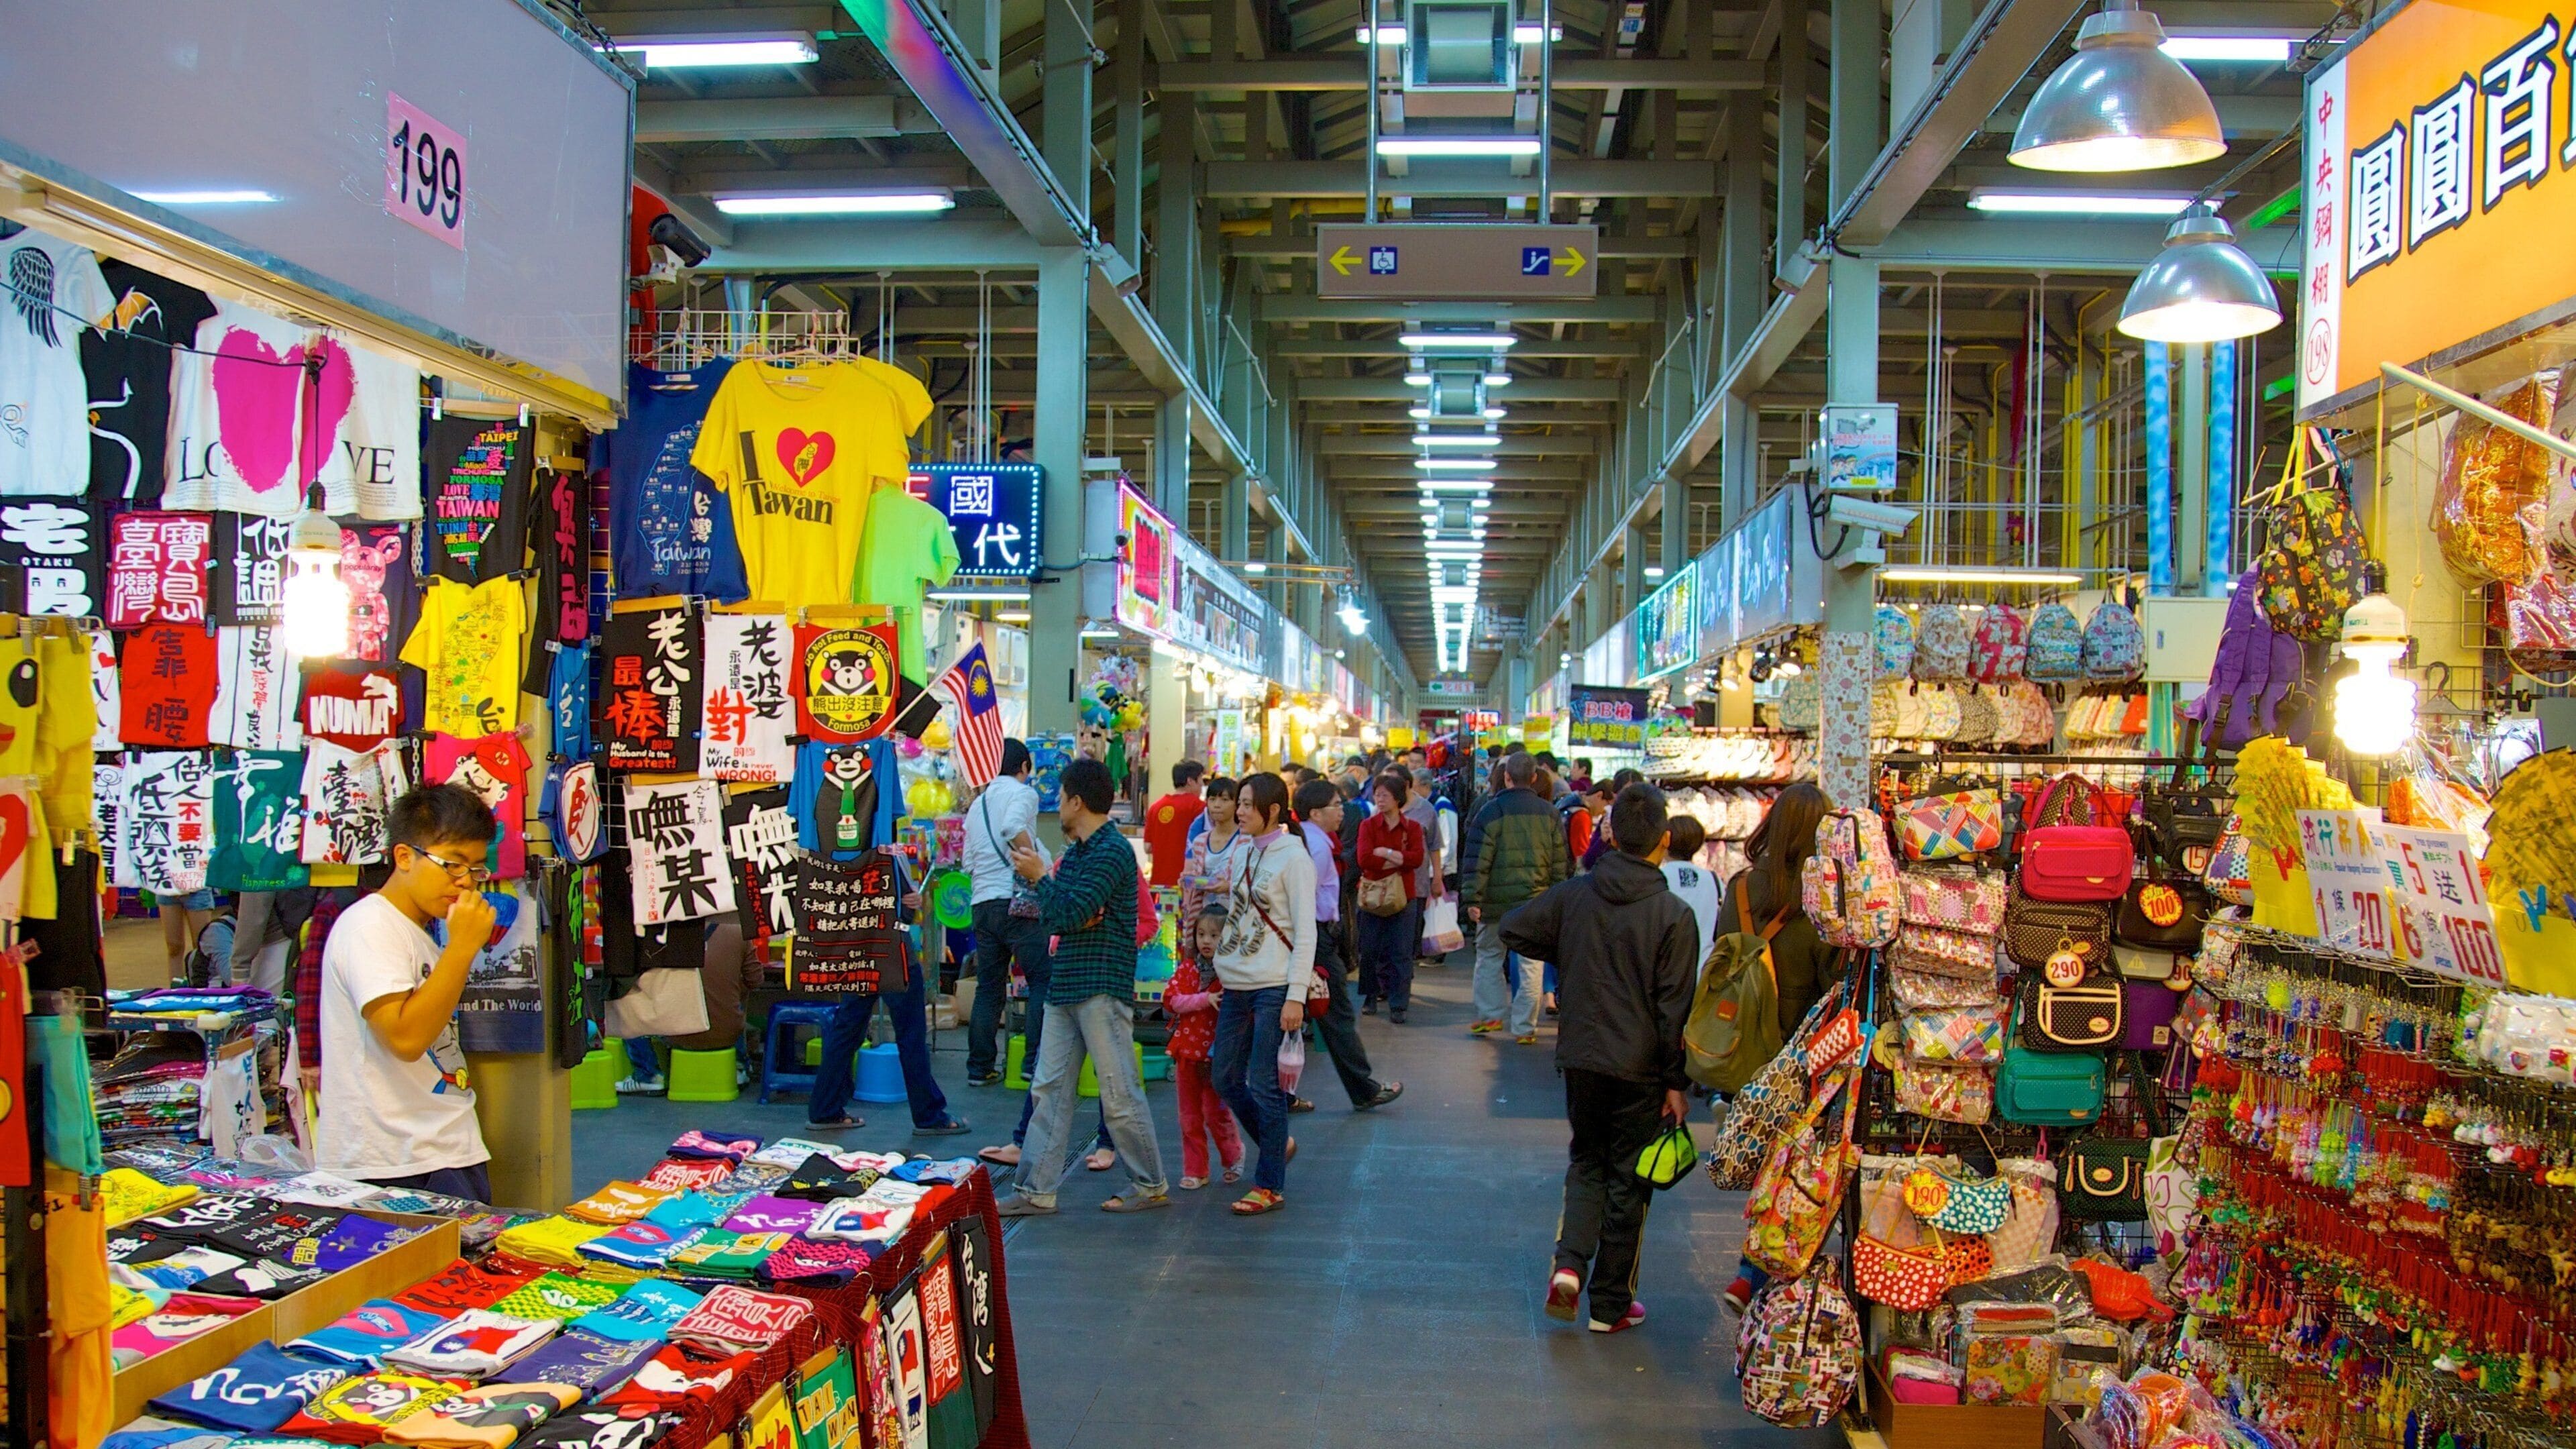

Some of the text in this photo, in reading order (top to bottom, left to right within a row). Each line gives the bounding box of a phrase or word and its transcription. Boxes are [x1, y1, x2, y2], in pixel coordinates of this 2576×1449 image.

[392, 119, 462, 230] 199
[2312, 90, 2334, 308] 中央鋼棚
[2309, 339, 2331, 372] 198
[480, 431, 518, 443] TAIPEI
[449, 475, 504, 485] FORMOSA
[443, 484, 470, 496] LOVE
[436, 500, 500, 519] TAIWAN
[650, 537, 711, 562] Taiwan
[21, 557, 73, 568] OTAKU
[646, 610, 691, 696] 老公
[804, 651, 815, 668] Do
[812, 635, 828, 653] Not
[825, 631, 851, 644] Feed
[853, 632, 872, 643] and
[740, 618, 788, 720] 老婆
[604, 655, 667, 747] 最棒
[812, 696, 884, 714] 熊出沒注意
[309, 694, 391, 736] KUMA
[705, 684, 757, 746] 對
[826, 719, 871, 730] Formosa
[610, 749, 670, 759] Husband is the
[611, 741, 627, 752] My
[708, 747, 721, 756] My
[608, 757, 677, 769] Greatest!
[706, 753, 740, 768] Wife
[714, 769, 777, 782] WRONG!
[242, 874, 286, 888] Happiness
[2400, 842, 2428, 895] 5
[2432, 869, 2463, 906] 送
[802, 896, 896, 915] 不知道自己在哪裡
[2147, 898, 2176, 918] 100
[2352, 891, 2384, 950] 20
[2443, 914, 2504, 983] 100
[2051, 961, 2081, 979] 290
[482, 999, 504, 1012] The
[506, 998, 542, 1012] World
[798, 1390, 831, 1424] TAI
[828, 1403, 856, 1441] WAN
